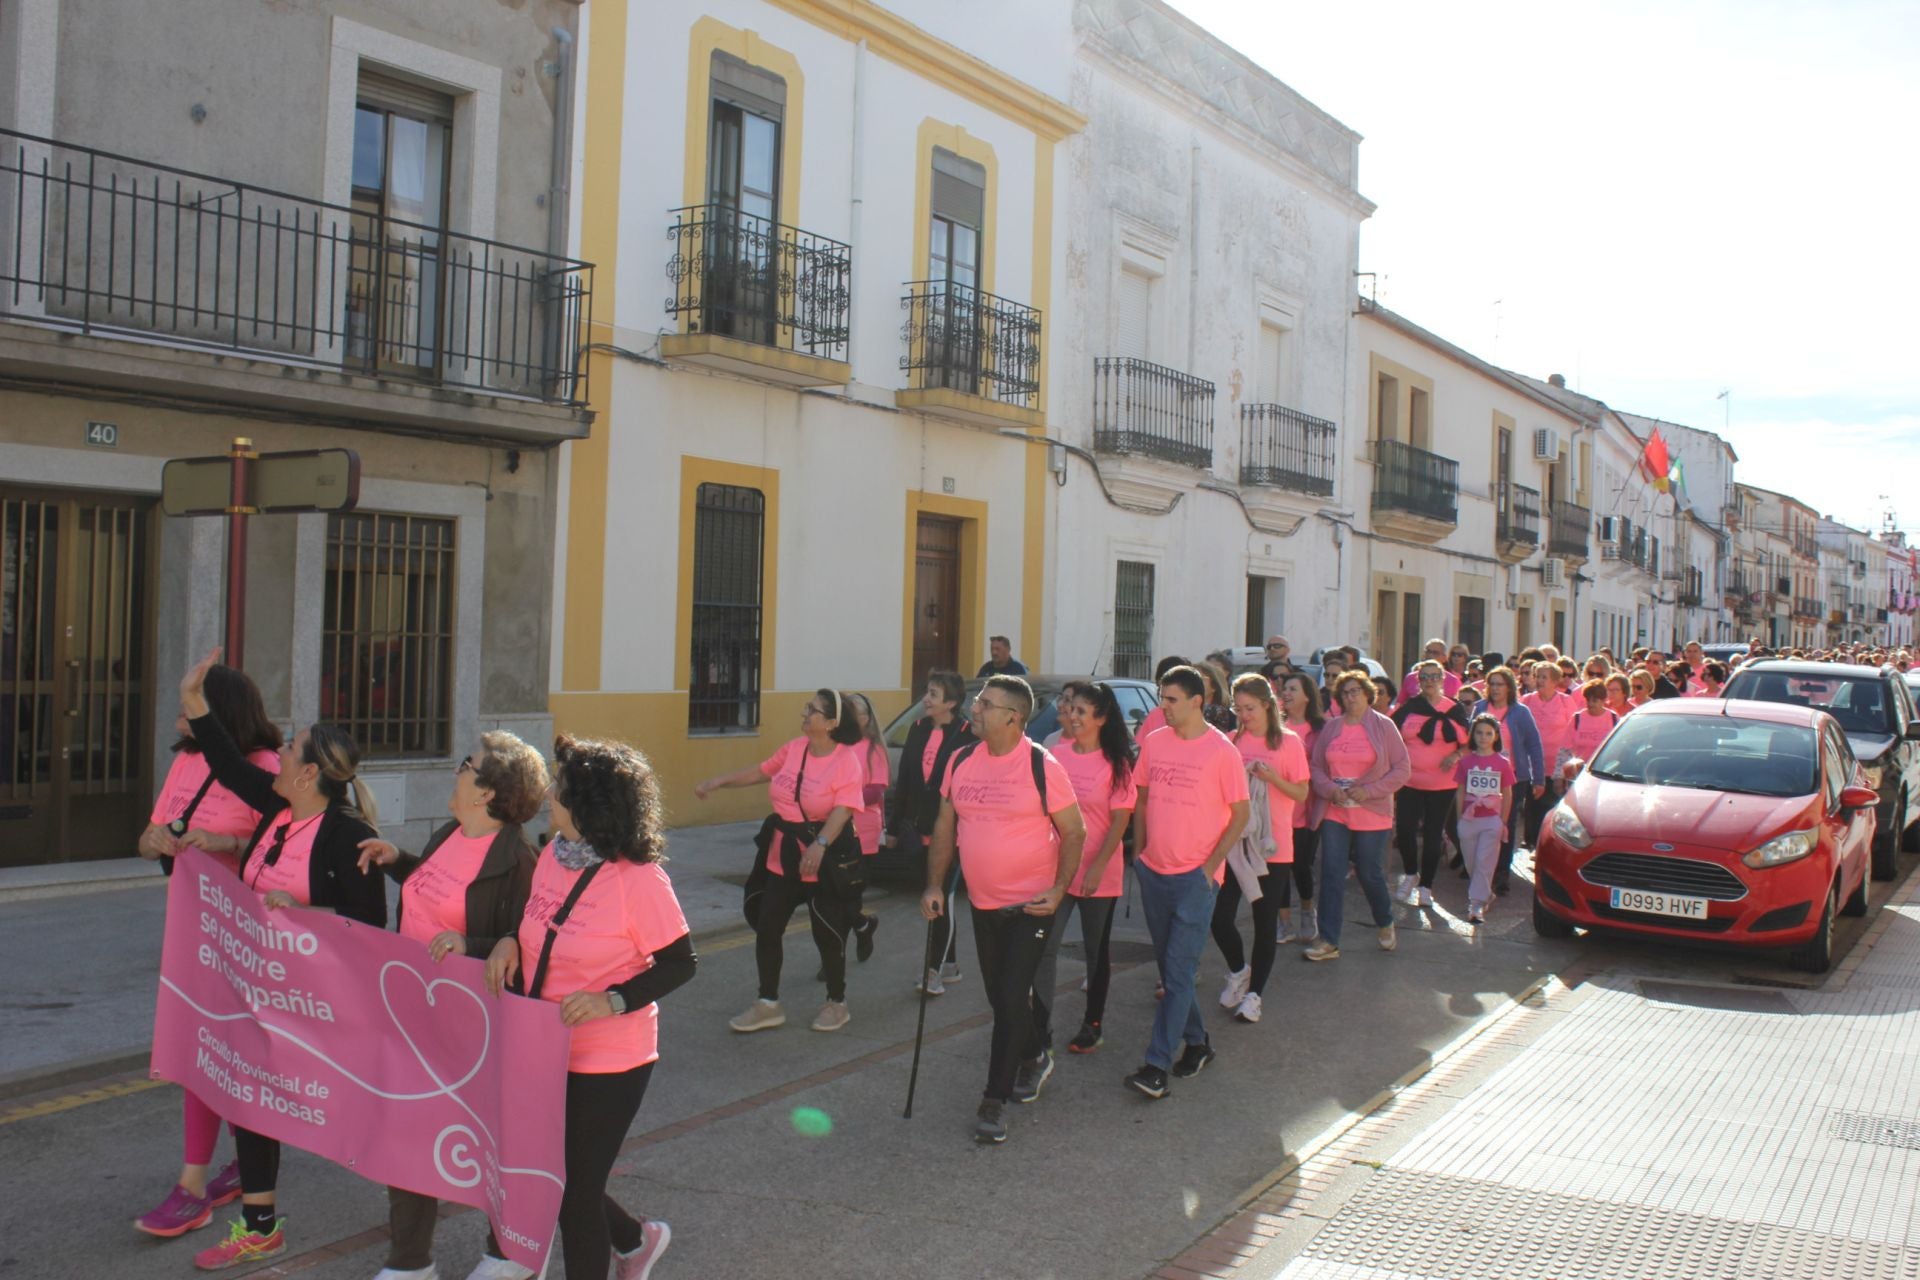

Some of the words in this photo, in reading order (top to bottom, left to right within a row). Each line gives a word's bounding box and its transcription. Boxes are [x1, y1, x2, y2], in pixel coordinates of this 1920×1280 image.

[90, 424, 116, 444] 40
[1471, 776, 1498, 789] 690
[198, 873, 232, 918] Este
[235, 906, 318, 956] camino
[1622, 892, 1664, 911] 0993
[1670, 898, 1703, 916] HVF
[200, 911, 218, 939] se
[219, 925, 287, 982] recorre
[198, 943, 222, 973] en
[223, 961, 336, 1023] compañía
[196, 1047, 254, 1103] Marchas
[259, 1085, 326, 1126] Rosas
[198, 1026, 232, 1063] Circuito
[232, 1051, 301, 1094] Provincial
[304, 1080, 330, 1099] de
